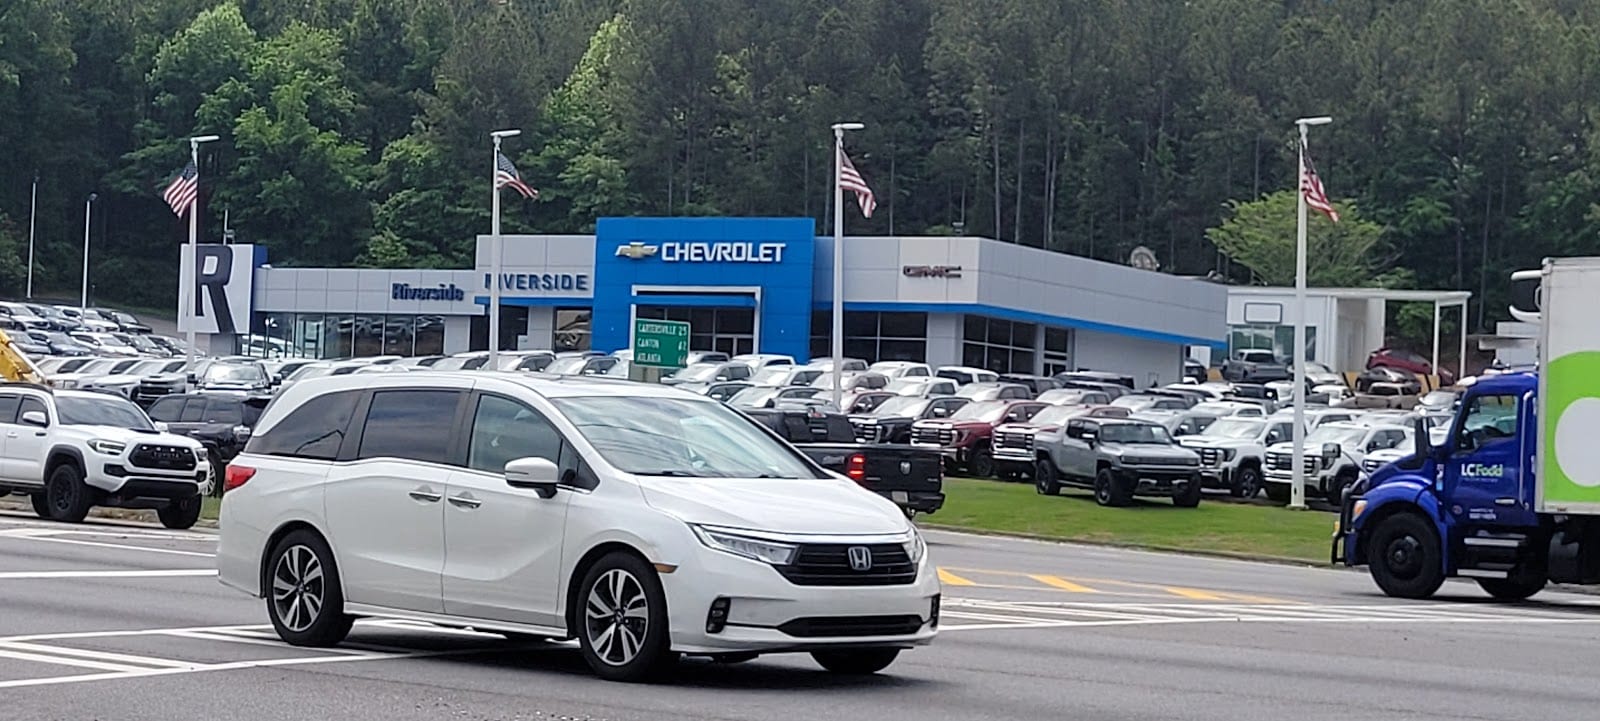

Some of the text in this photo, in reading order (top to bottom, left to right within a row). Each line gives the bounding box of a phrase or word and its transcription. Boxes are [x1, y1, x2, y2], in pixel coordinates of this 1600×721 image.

[661, 242, 786, 263] CHEVROLET
[903, 265, 962, 279] GMC
[195, 245, 237, 334] R
[392, 282, 465, 301] Riverside
[637, 323, 687, 337] CARTERSVILLE 25
[637, 337, 659, 349] CANTON
[636, 352, 662, 363] ATLANTA
